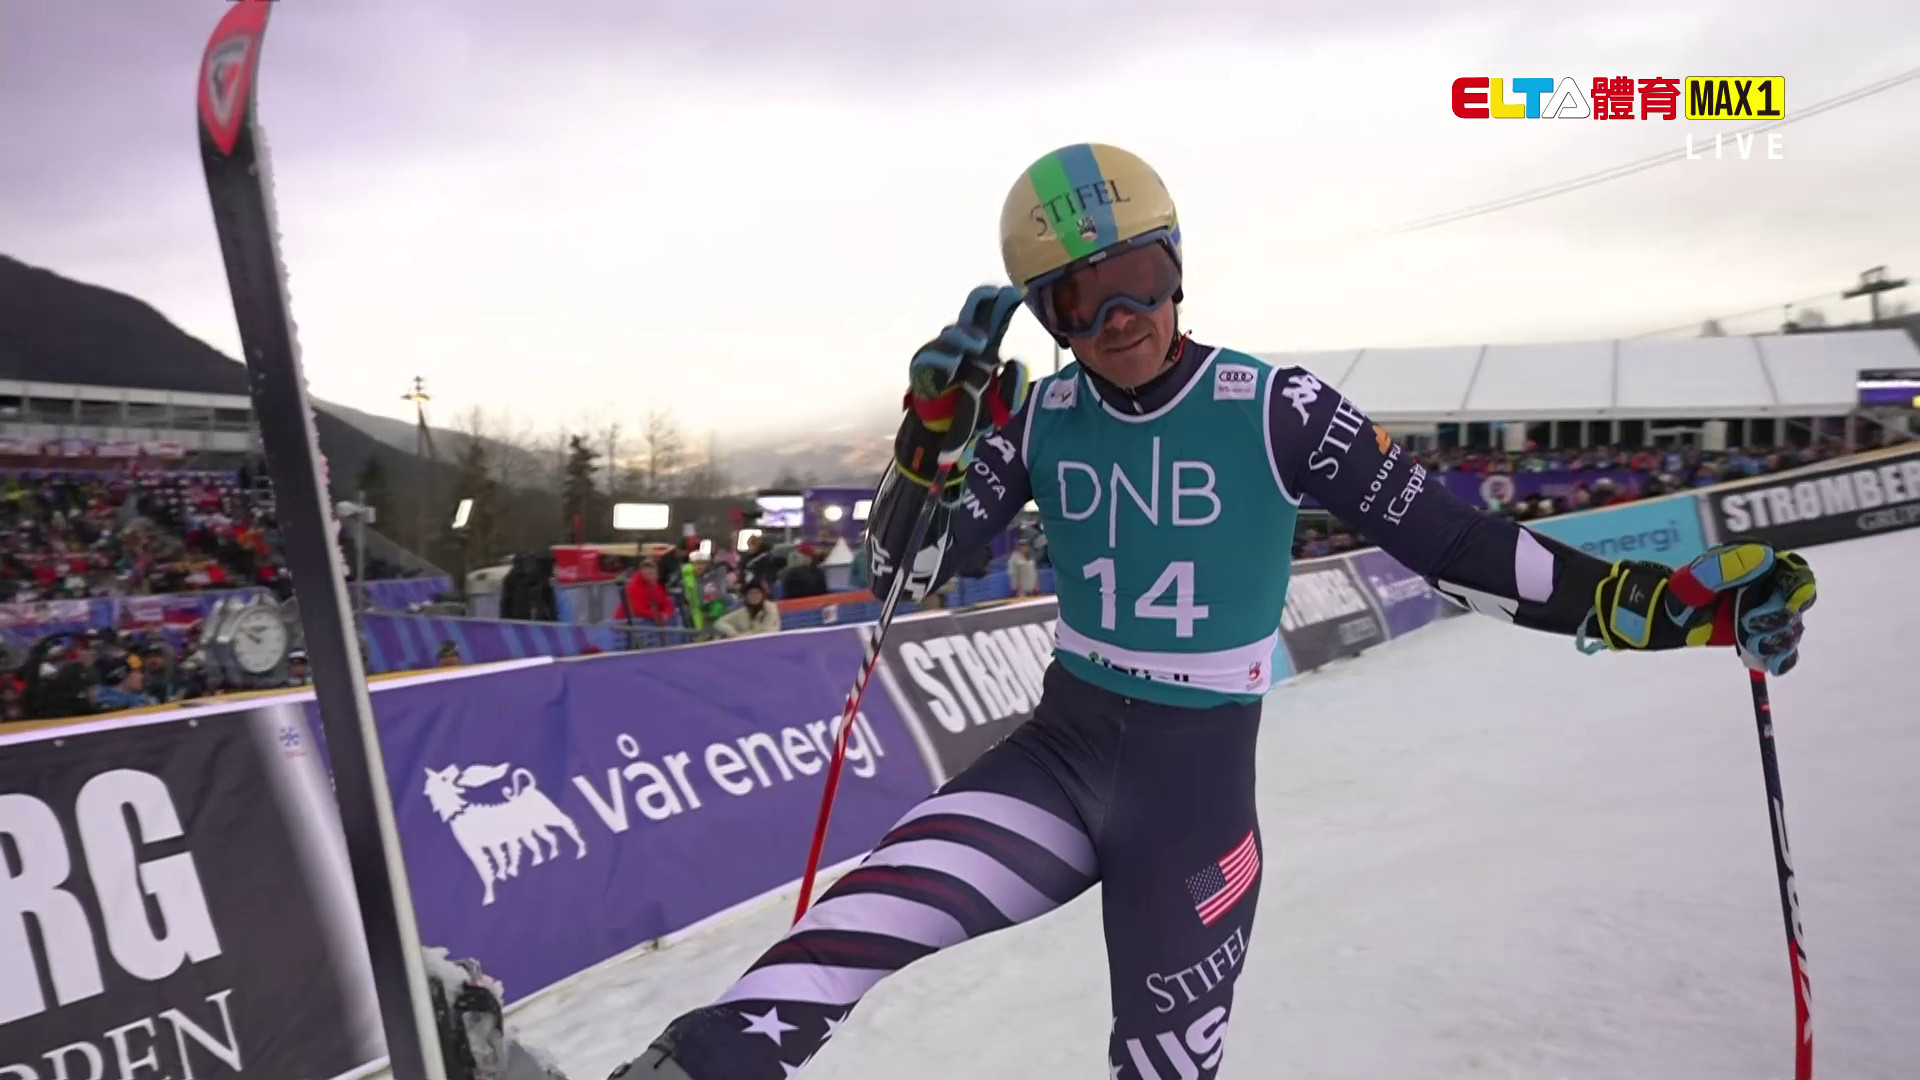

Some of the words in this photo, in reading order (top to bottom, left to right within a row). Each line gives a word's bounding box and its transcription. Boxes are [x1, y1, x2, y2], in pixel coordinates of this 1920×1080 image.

[1030, 179, 1131, 238] STIFEL
[972, 457, 1006, 500] OTA
[1308, 396, 1365, 481] STIF
[1057, 436, 1222, 548] DNB
[1082, 556, 1209, 638] 14
[900, 620, 1057, 734] STRØMB
[572, 733, 701, 834] vår
[704, 693, 884, 778] energi
[1145, 926, 1250, 1014] STIFEL
